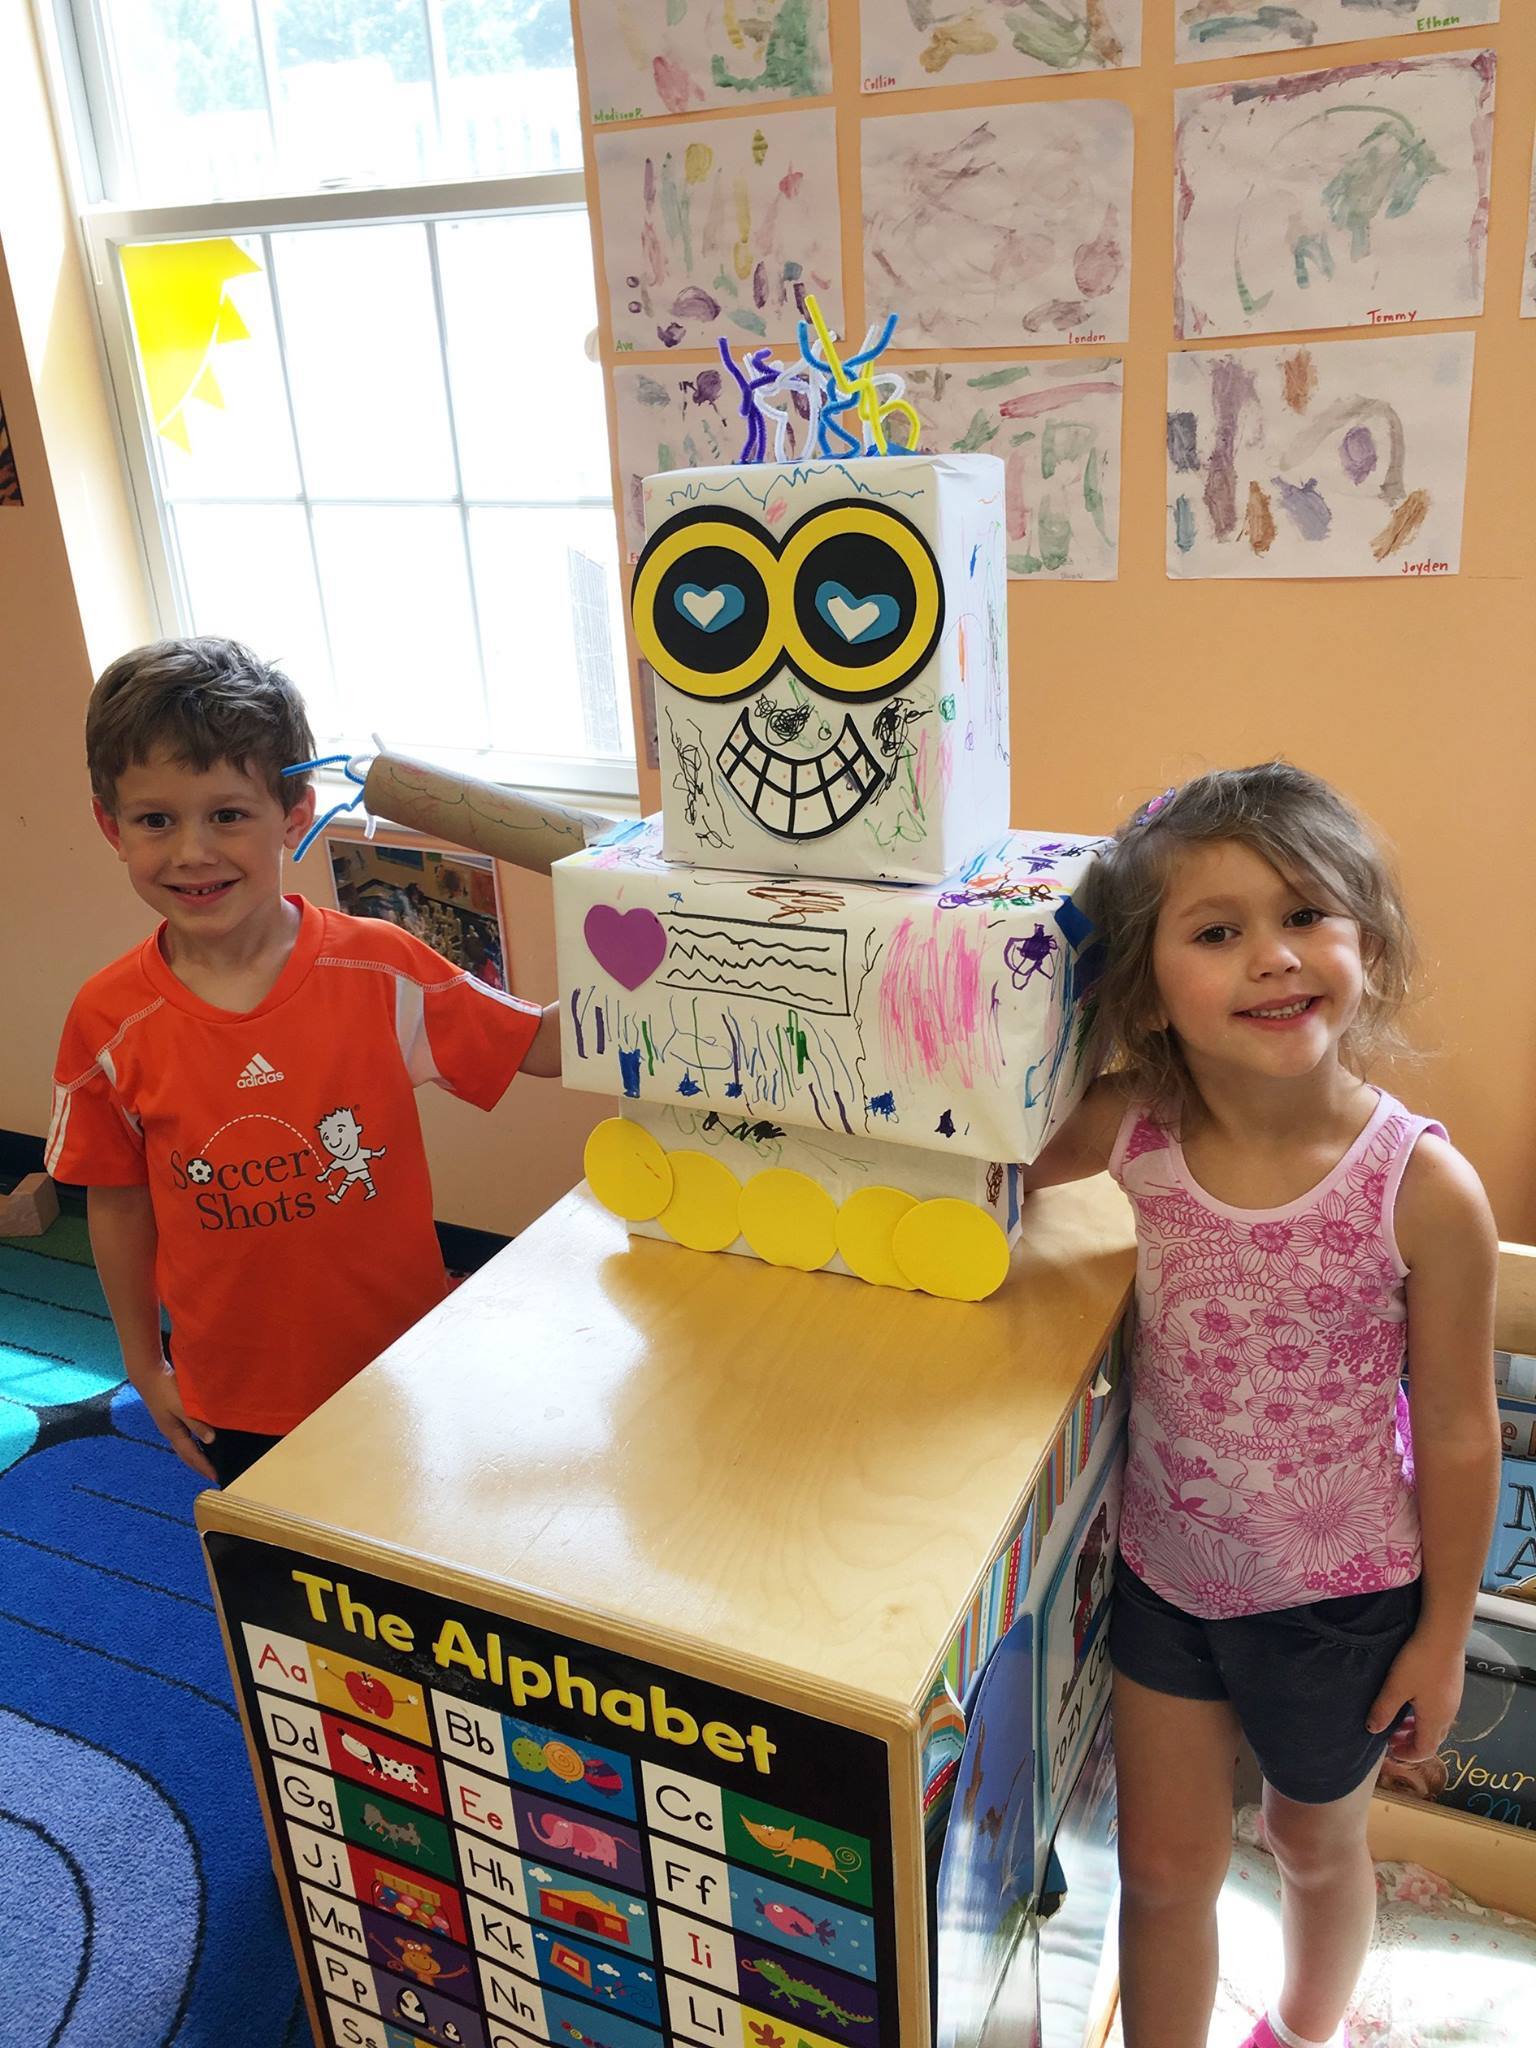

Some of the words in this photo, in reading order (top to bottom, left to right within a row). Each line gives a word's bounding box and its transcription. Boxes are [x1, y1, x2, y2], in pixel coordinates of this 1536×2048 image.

[1366, 308, 1417, 325] Tommy
[236, 1070, 285, 1089] adidas
[170, 1149, 310, 1191] Soccer
[196, 1191, 316, 1231] Shots
[257, 1643, 307, 1686] Aa
[291, 1570, 415, 1654] The
[431, 1619, 777, 1775] Alphabet
[270, 1713, 318, 1757] Dd
[446, 1709, 495, 1757] Bb
[283, 1775, 335, 1829] Gg
[459, 1784, 503, 1831] Ee
[655, 1784, 714, 1832] Cc
[303, 1841, 341, 1887] Jj
[470, 1850, 515, 1897] Hh
[664, 1859, 717, 1906] Ff
[309, 1895, 364, 1944] Mm
[484, 1914, 524, 1960] Kk
[687, 1931, 713, 1969] Ii
[328, 1957, 368, 2003] Pp
[492, 1978, 535, 2022] Nn
[688, 1995, 725, 2037] Ll
